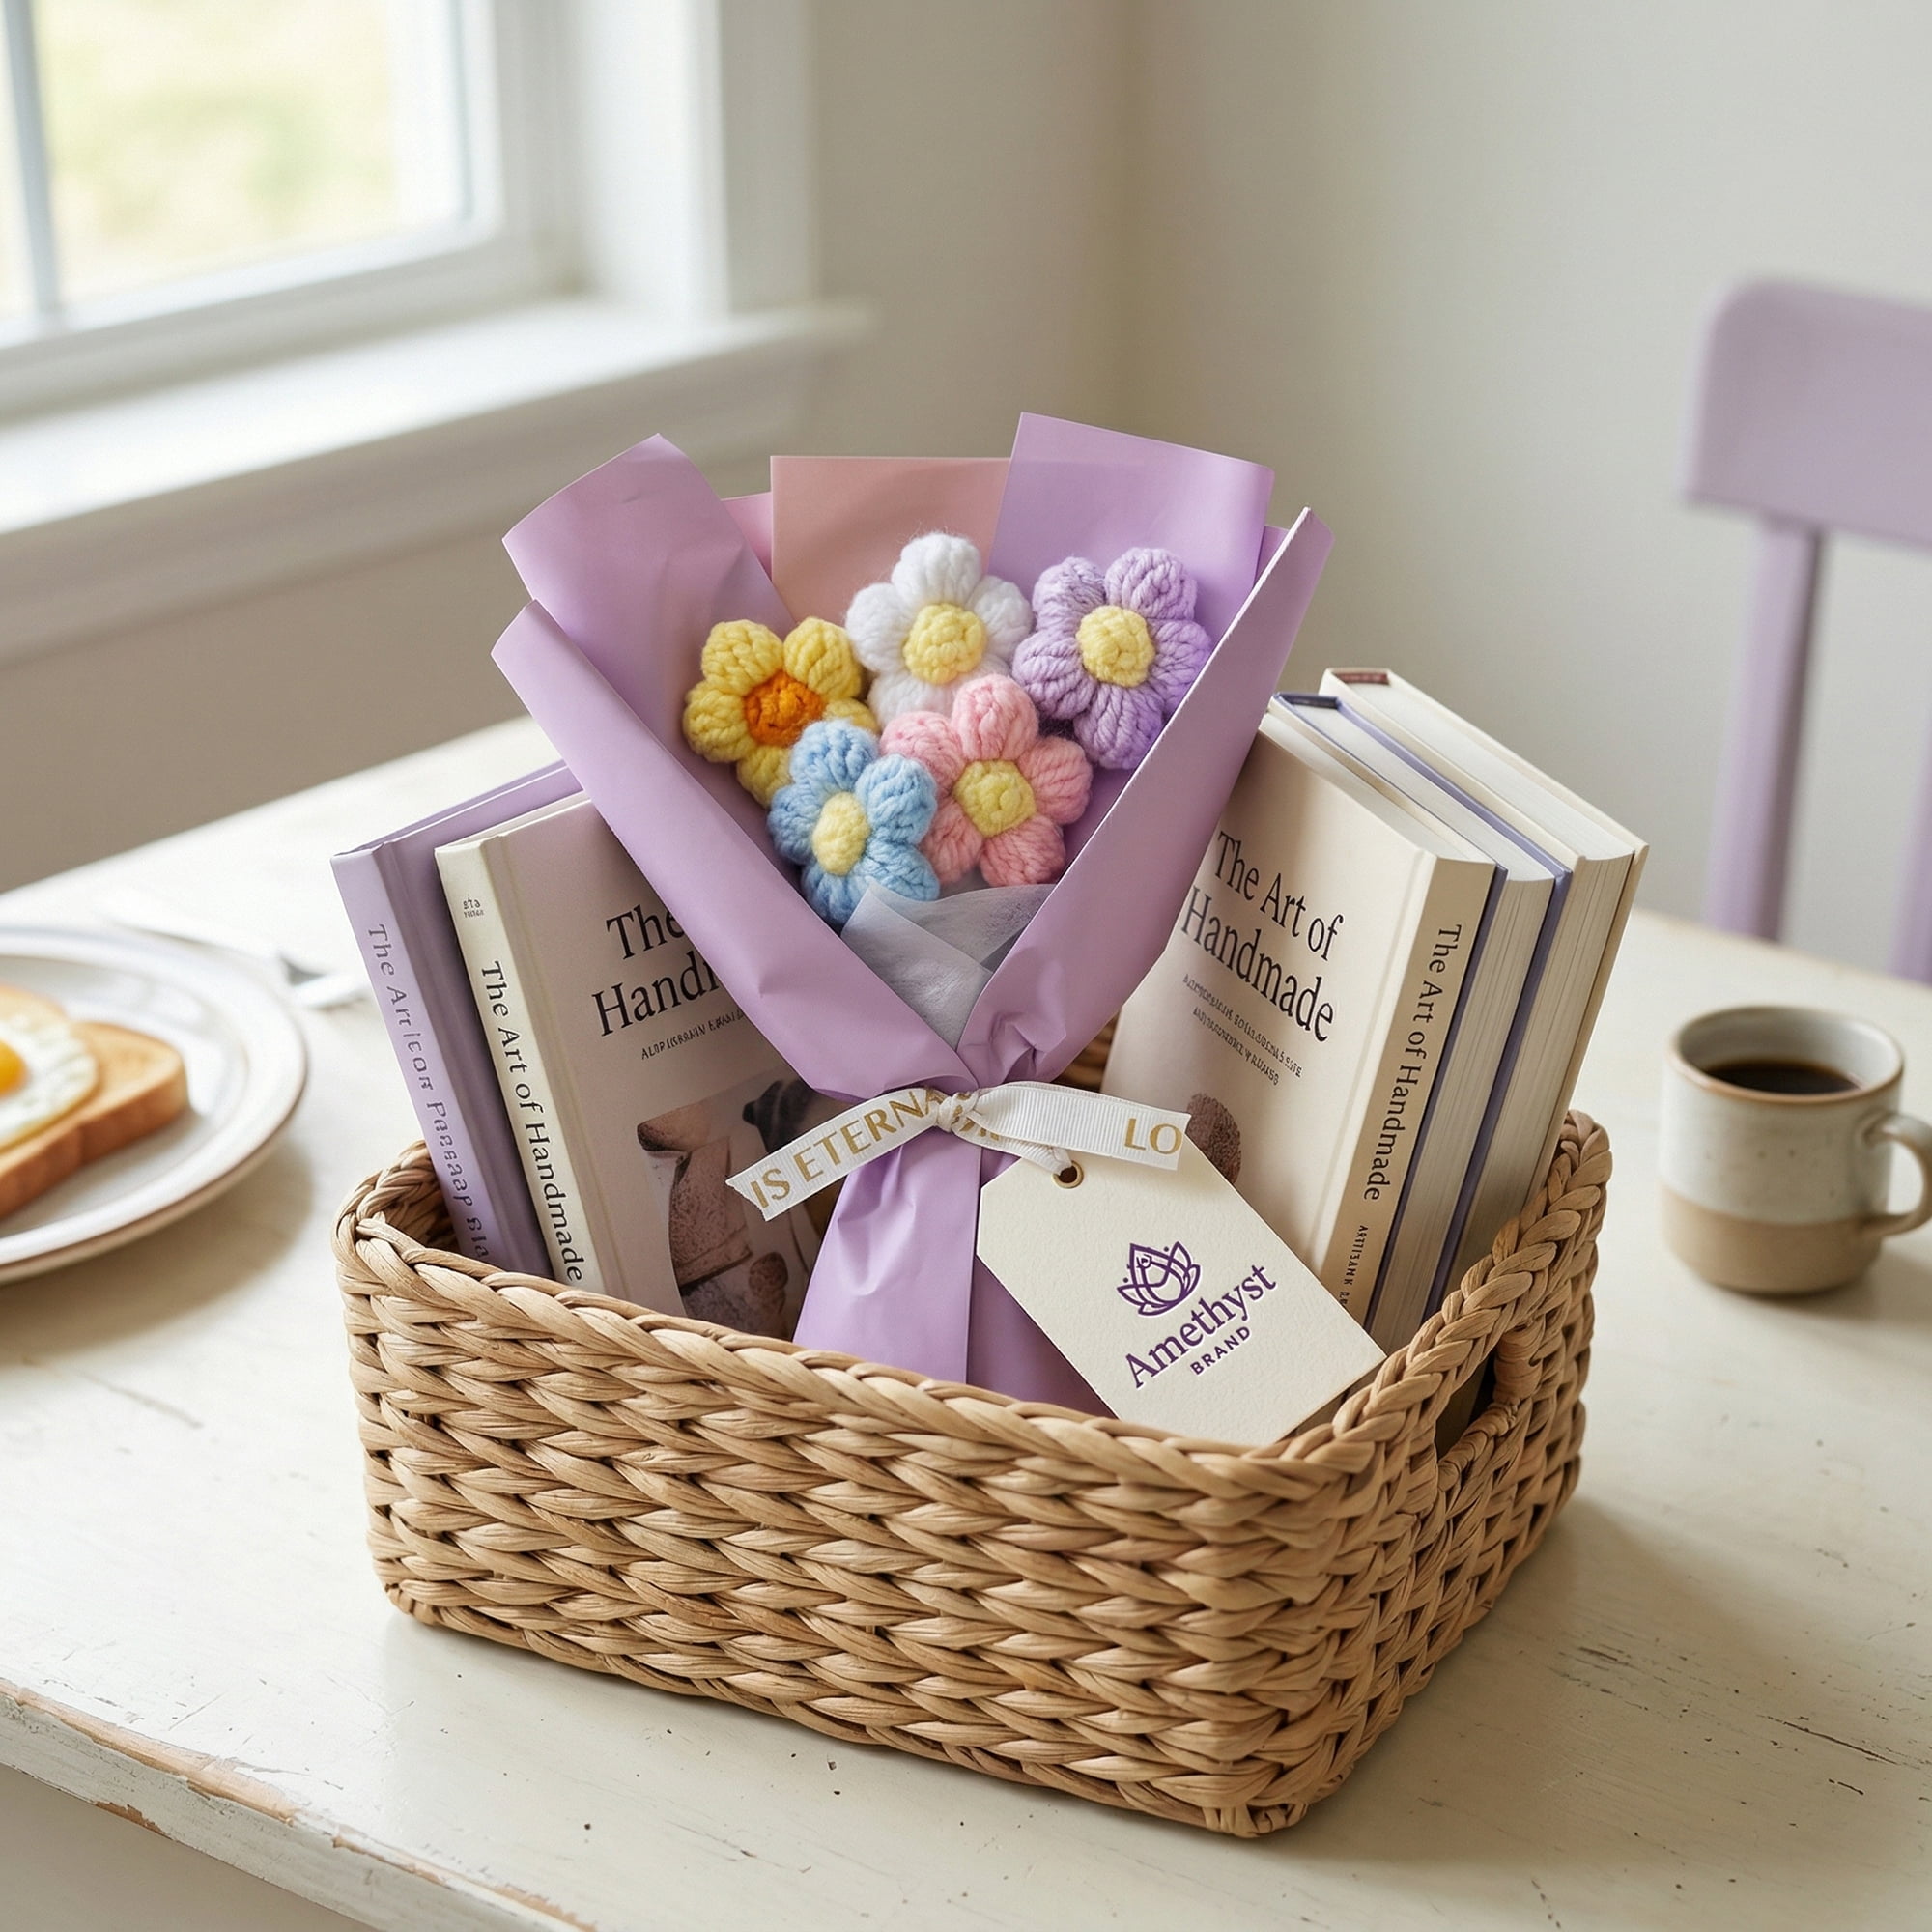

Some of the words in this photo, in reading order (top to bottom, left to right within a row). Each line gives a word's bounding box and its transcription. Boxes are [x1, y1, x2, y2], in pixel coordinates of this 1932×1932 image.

[1214, 830, 1260, 901] The
[1259, 872, 1306, 938] Art
[1307, 913, 1345, 962] of
[368, 923, 395, 976] The
[1180, 884, 1334, 1042] Handmade
[1429, 923, 1462, 973] The
[481, 960, 509, 1018] The
[591, 950, 719, 1037] Hand
[1412, 980, 1443, 1024] Art
[497, 1026, 527, 1074] Art
[1404, 1030, 1428, 1059] of
[514, 1082, 544, 1114] of
[1123, 1117, 1183, 1154] LO
[1363, 1064, 1422, 1201] Handmade
[525, 1119, 583, 1283] Handmade
[749, 1167, 792, 1209] IS
[1125, 1264, 1276, 1388] Amethyst
[1190, 1326, 1251, 1376] BRAND
